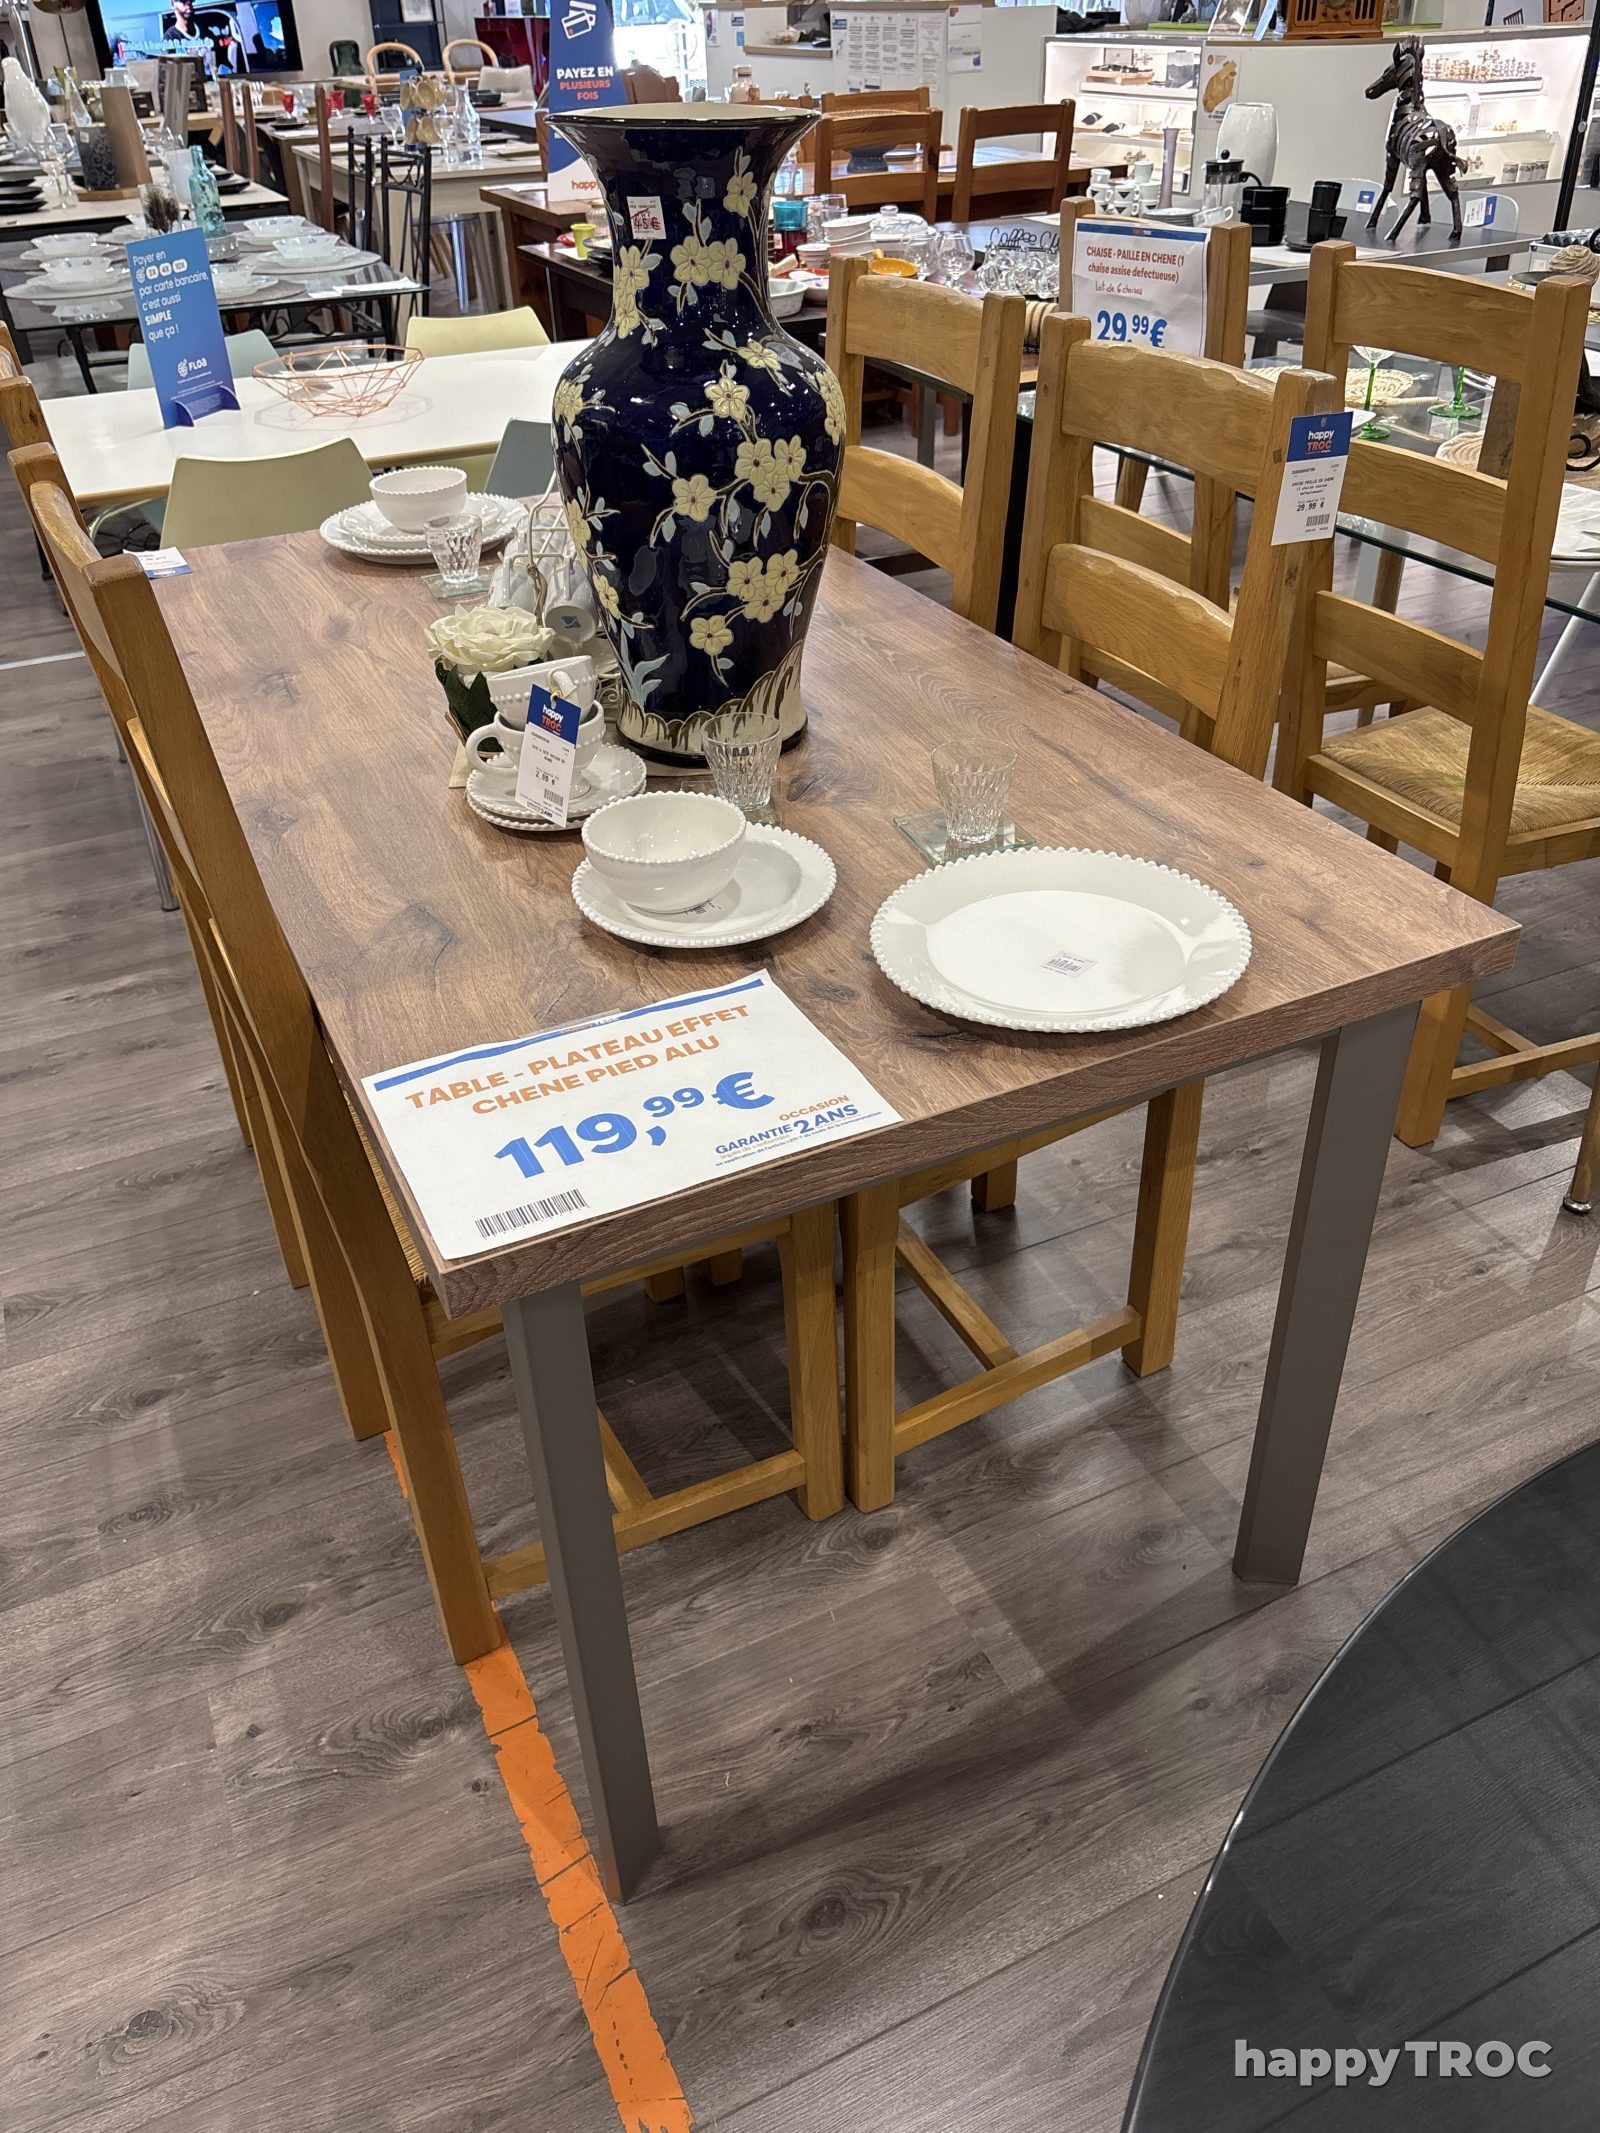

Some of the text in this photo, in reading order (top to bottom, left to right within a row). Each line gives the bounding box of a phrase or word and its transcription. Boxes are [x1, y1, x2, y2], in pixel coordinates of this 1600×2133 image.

[556, 66, 614, 79] PAYEZ EN
[560, 80, 611, 91] PLUSIEURS
[577, 91, 599, 100] FOIS
[571, 180, 600, 191] happ
[989, 227, 1037, 247] Coffee
[132, 250, 166, 267] Payer en
[1086, 246, 1112, 258] CHAISE
[1117, 249, 1140, 262] PAILLE
[1141, 251, 1151, 262] EN
[1151, 252, 1177, 265] CHENE
[1177, 255, 1185, 268] (1
[1088, 262, 1179, 284] chaise assise defectueuse)
[139, 271, 209, 299] par carte bancaire,
[161, 291, 181, 305] aussi
[145, 310, 172, 325] SIMPLE
[148, 330, 163, 343] que
[1308, 430, 1335, 441] happy
[1307, 440, 1332, 451] TROC
[542, 704, 564, 723] happy
[541, 715, 562, 732] TROC
[404, 1071, 511, 1109] TABLE
[527, 1029, 664, 1076] PLATEAU
[665, 1005, 750, 1038] EFFET
[471, 1035, 720, 1115] CHENE PIED ALU
[778, 1094, 850, 1122] OCCASION
[715, 1104, 859, 1154] GARANTIE 2 ANS
